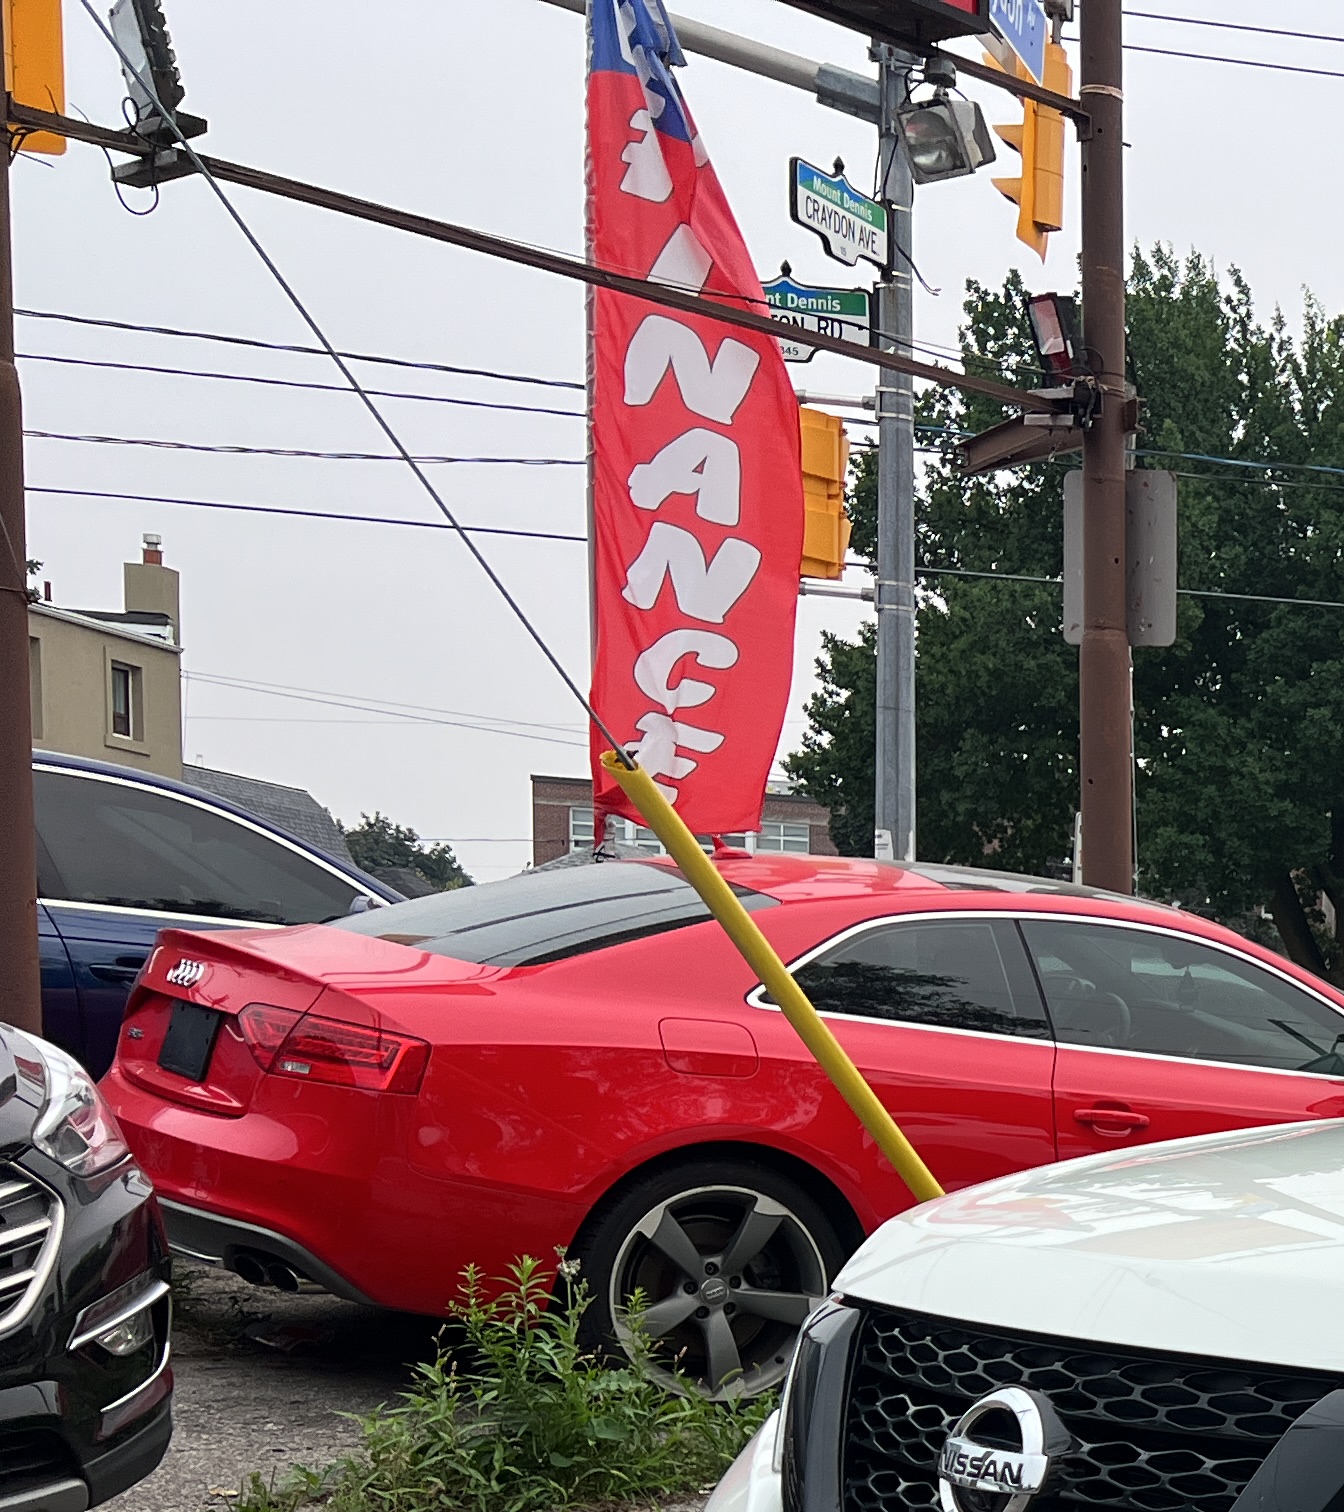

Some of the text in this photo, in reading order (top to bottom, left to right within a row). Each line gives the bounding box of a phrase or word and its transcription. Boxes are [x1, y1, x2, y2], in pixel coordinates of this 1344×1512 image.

[813, 175, 873, 222] Mount Dennis
[805, 195, 878, 255] CRAYDON AVE
[787, 292, 841, 312] Dennis
[940, 1446, 1024, 1486] NISSAN
